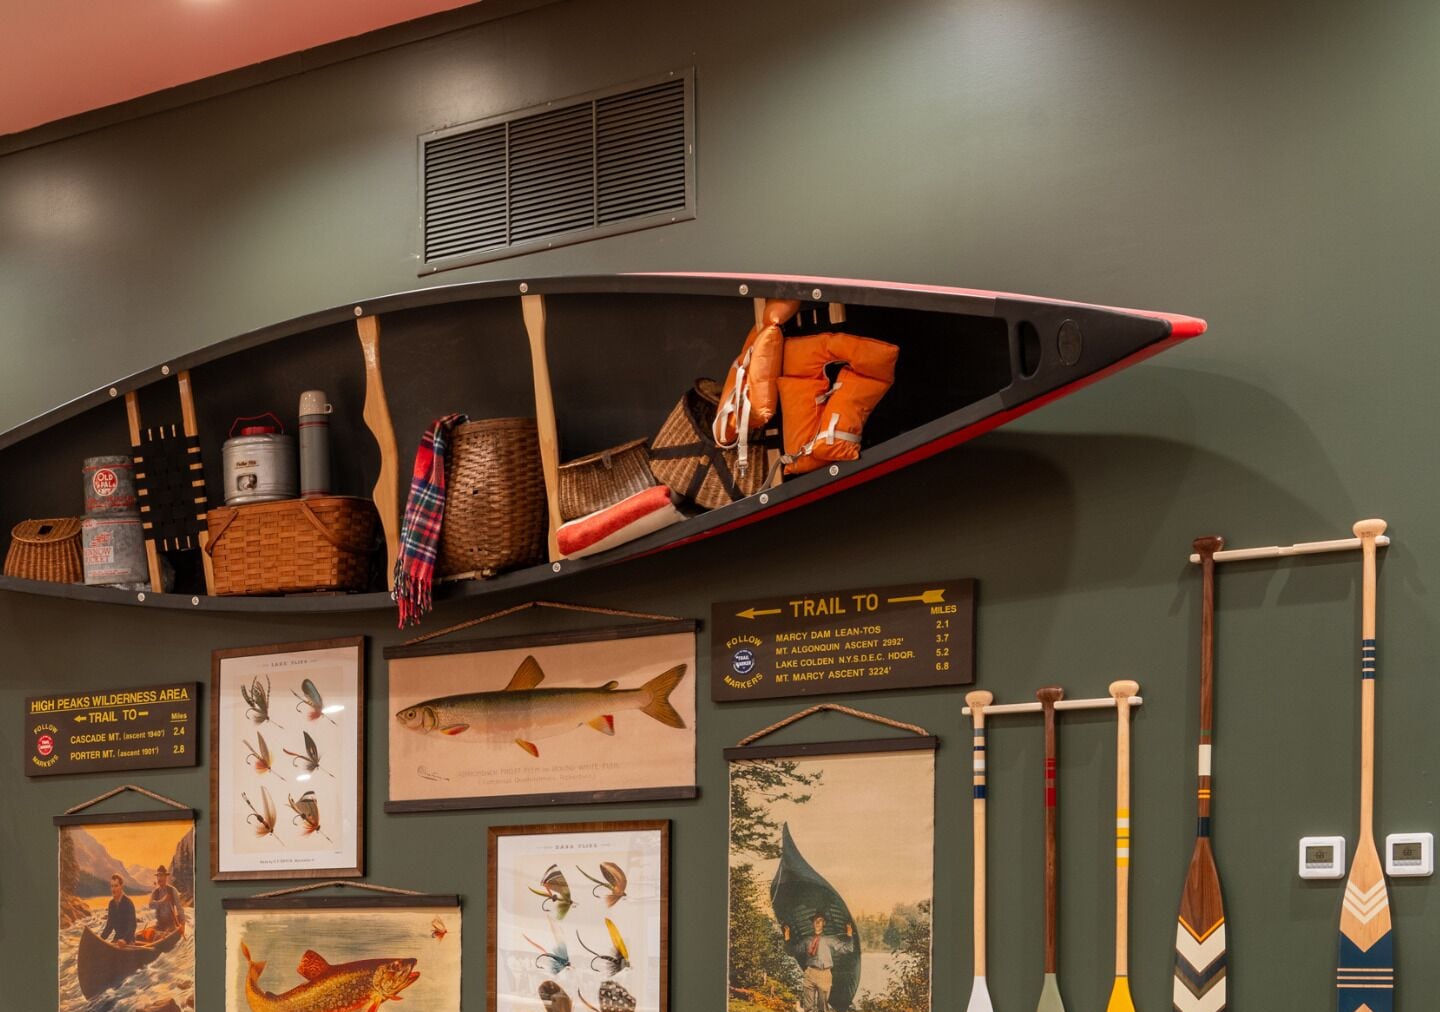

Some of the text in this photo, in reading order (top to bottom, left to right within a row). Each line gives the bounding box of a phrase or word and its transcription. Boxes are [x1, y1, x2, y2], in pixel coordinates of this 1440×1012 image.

[96, 472, 113, 481] OLD
[789, 593, 879, 618] TRAIL TO
[931, 604, 957, 615] MILES
[775, 619, 949, 642] MARCY DAM LEAN-TOS 2.1
[726, 635, 763, 649] FOLLOW
[791, 643, 840, 654] ALGONQUIN
[845, 640, 879, 650] ASCENT
[936, 633, 949, 643] 3.7
[775, 659, 798, 669] LAKE
[800, 657, 834, 667] COLDEN
[936, 647, 949, 657] 5.2
[792, 671, 825, 681] MARCY
[828, 668, 865, 679] ASCENT
[936, 661, 949, 671] 6.8
[724, 672, 763, 689] MARKERS
[31, 688, 188, 712] HIGH PEAKS WILDERNESS AREA
[89, 708, 137, 723] TRAIL TO
[171, 712, 188, 720] Miles
[33, 724, 59, 735] FOLLOW
[70, 734, 106, 744] CASCADE
[108, 732, 122, 741] MT.
[173, 726, 185, 736] 2.4
[70, 750, 101, 760] PORTER
[102, 750, 116, 758] MT.
[173, 744, 185, 754] 2.8
[32, 755, 59, 768] MARKERS
